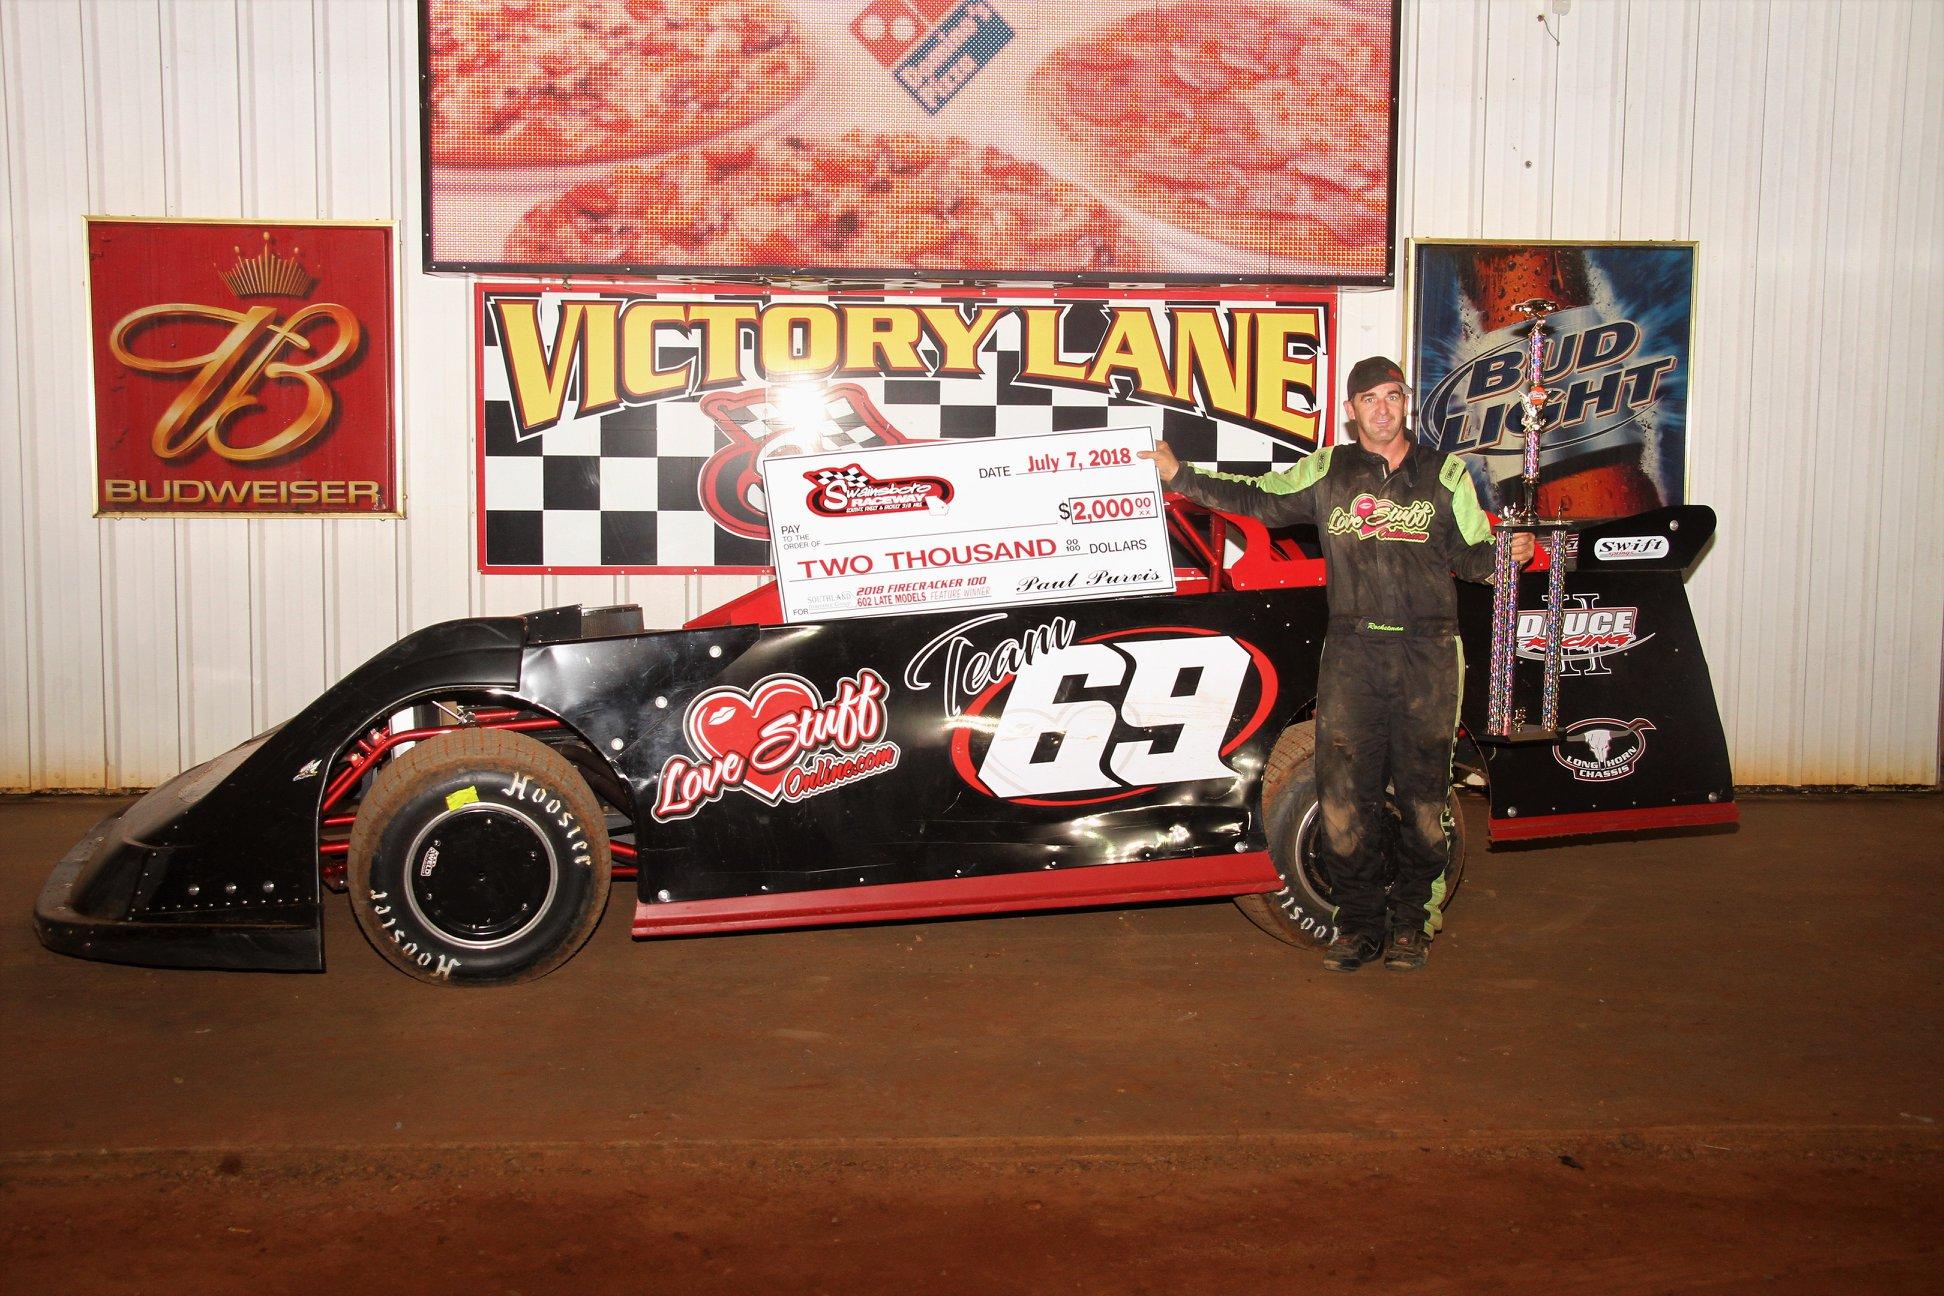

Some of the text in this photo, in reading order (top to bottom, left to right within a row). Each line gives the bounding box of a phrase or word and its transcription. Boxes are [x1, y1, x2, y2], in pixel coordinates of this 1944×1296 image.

[492, 299, 1322, 450] VICTORY LANE
[1467, 320, 1643, 404] BUD
[979, 448, 1131, 478] DATE July 7, 2018
[105, 479, 380, 504] BUDWEISER
[824, 480, 932, 510] Swainsboro
[851, 494, 926, 507] RACEWAY
[781, 525, 801, 535] PAY
[1329, 503, 1432, 531] Love Stuff
[783, 535, 793, 543] TO
[783, 542, 809, 551] ORDER
[797, 538, 1147, 578] TWO THOUSAND DOLLARS
[856, 576, 987, 596] 2018 FIRECRACKER 100
[1016, 568, 1160, 592] Paul Purvis
[857, 596, 872, 607] 602
[874, 595, 893, 606] LATE
[895, 592, 927, 603] MODELS
[930, 588, 961, 600] FEATURE
[964, 586, 991, 597] WINNER
[1517, 611, 1633, 637] DUCE
[904, 613, 1076, 717] Team
[976, 634, 1253, 798] 69
[655, 673, 882, 816] Love Stuff
[1566, 746, 1637, 768] LONG HORN
[785, 746, 896, 798] Online.com
[1579, 764, 1629, 778] CHASSIS
[502, 772, 592, 866] Hoosier
[370, 889, 461, 981] Hoosier
